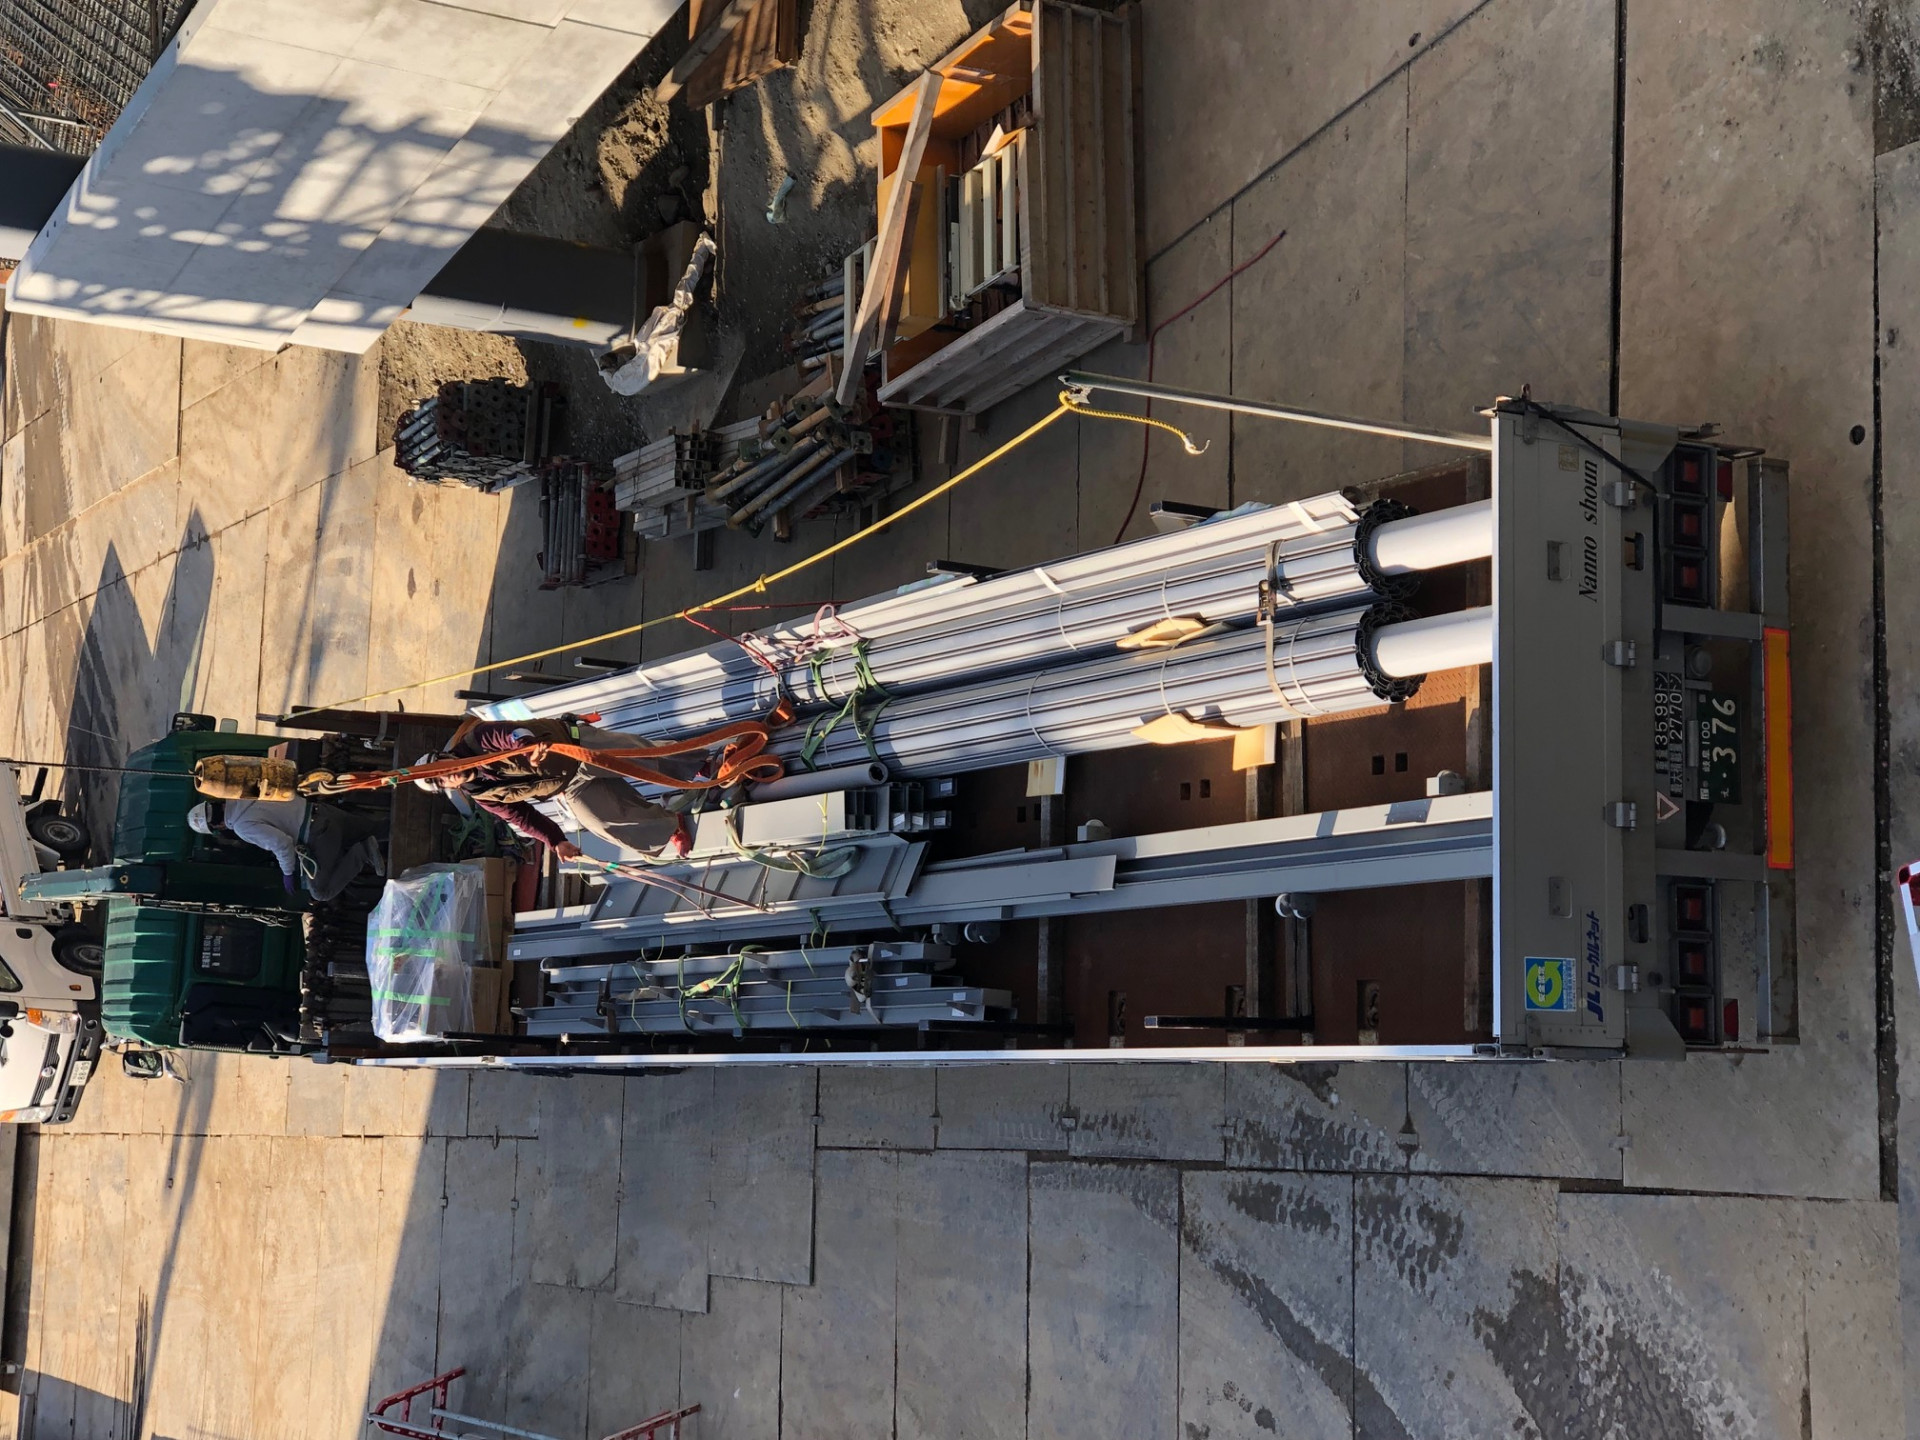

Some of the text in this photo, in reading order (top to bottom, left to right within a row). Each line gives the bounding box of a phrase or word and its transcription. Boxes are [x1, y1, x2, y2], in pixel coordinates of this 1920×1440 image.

[1578, 459, 1597, 604] Nanno shoun
[1702, 721, 1710, 745] 100
[1585, 910, 1600, 988] ローカルネット
